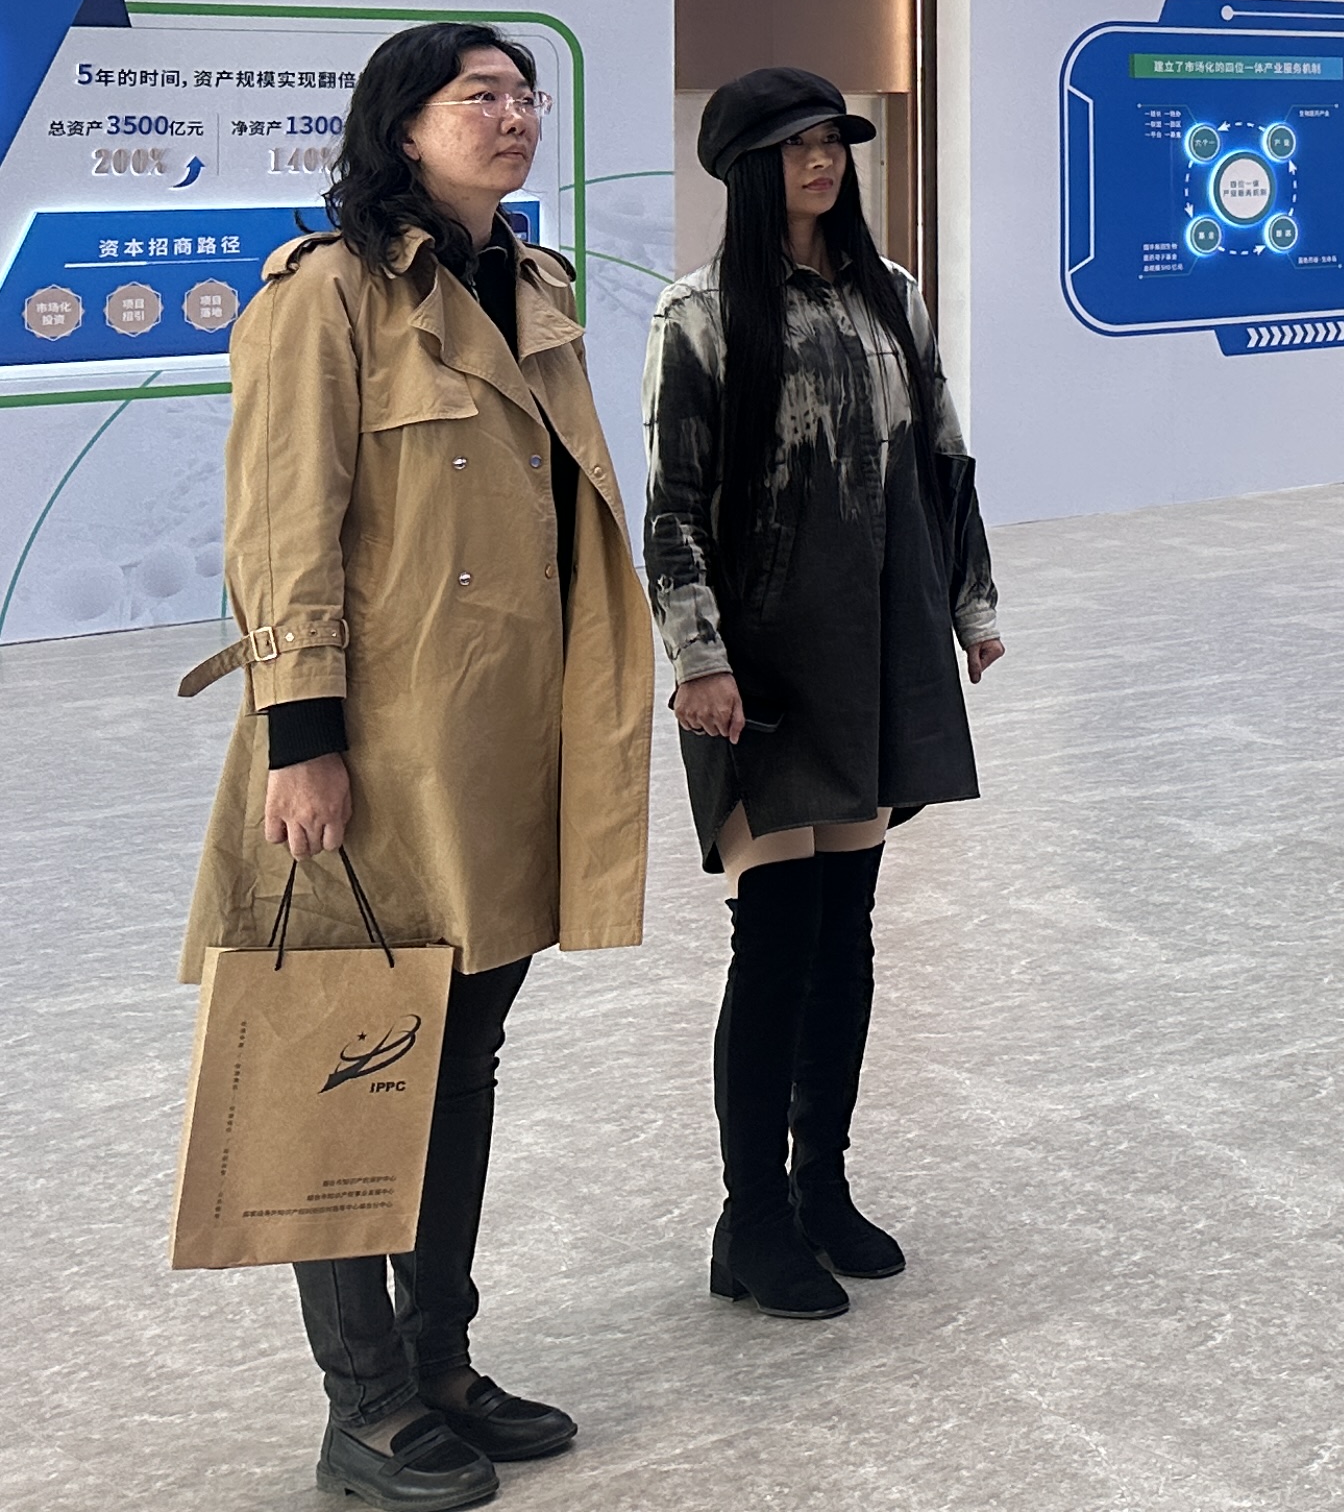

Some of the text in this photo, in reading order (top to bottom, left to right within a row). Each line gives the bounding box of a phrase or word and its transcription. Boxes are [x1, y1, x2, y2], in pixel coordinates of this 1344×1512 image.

[98, 236, 241, 258] 资本招商路径
[36, 301, 72, 314] 市场化
[369, 1080, 406, 1094] IPPC
